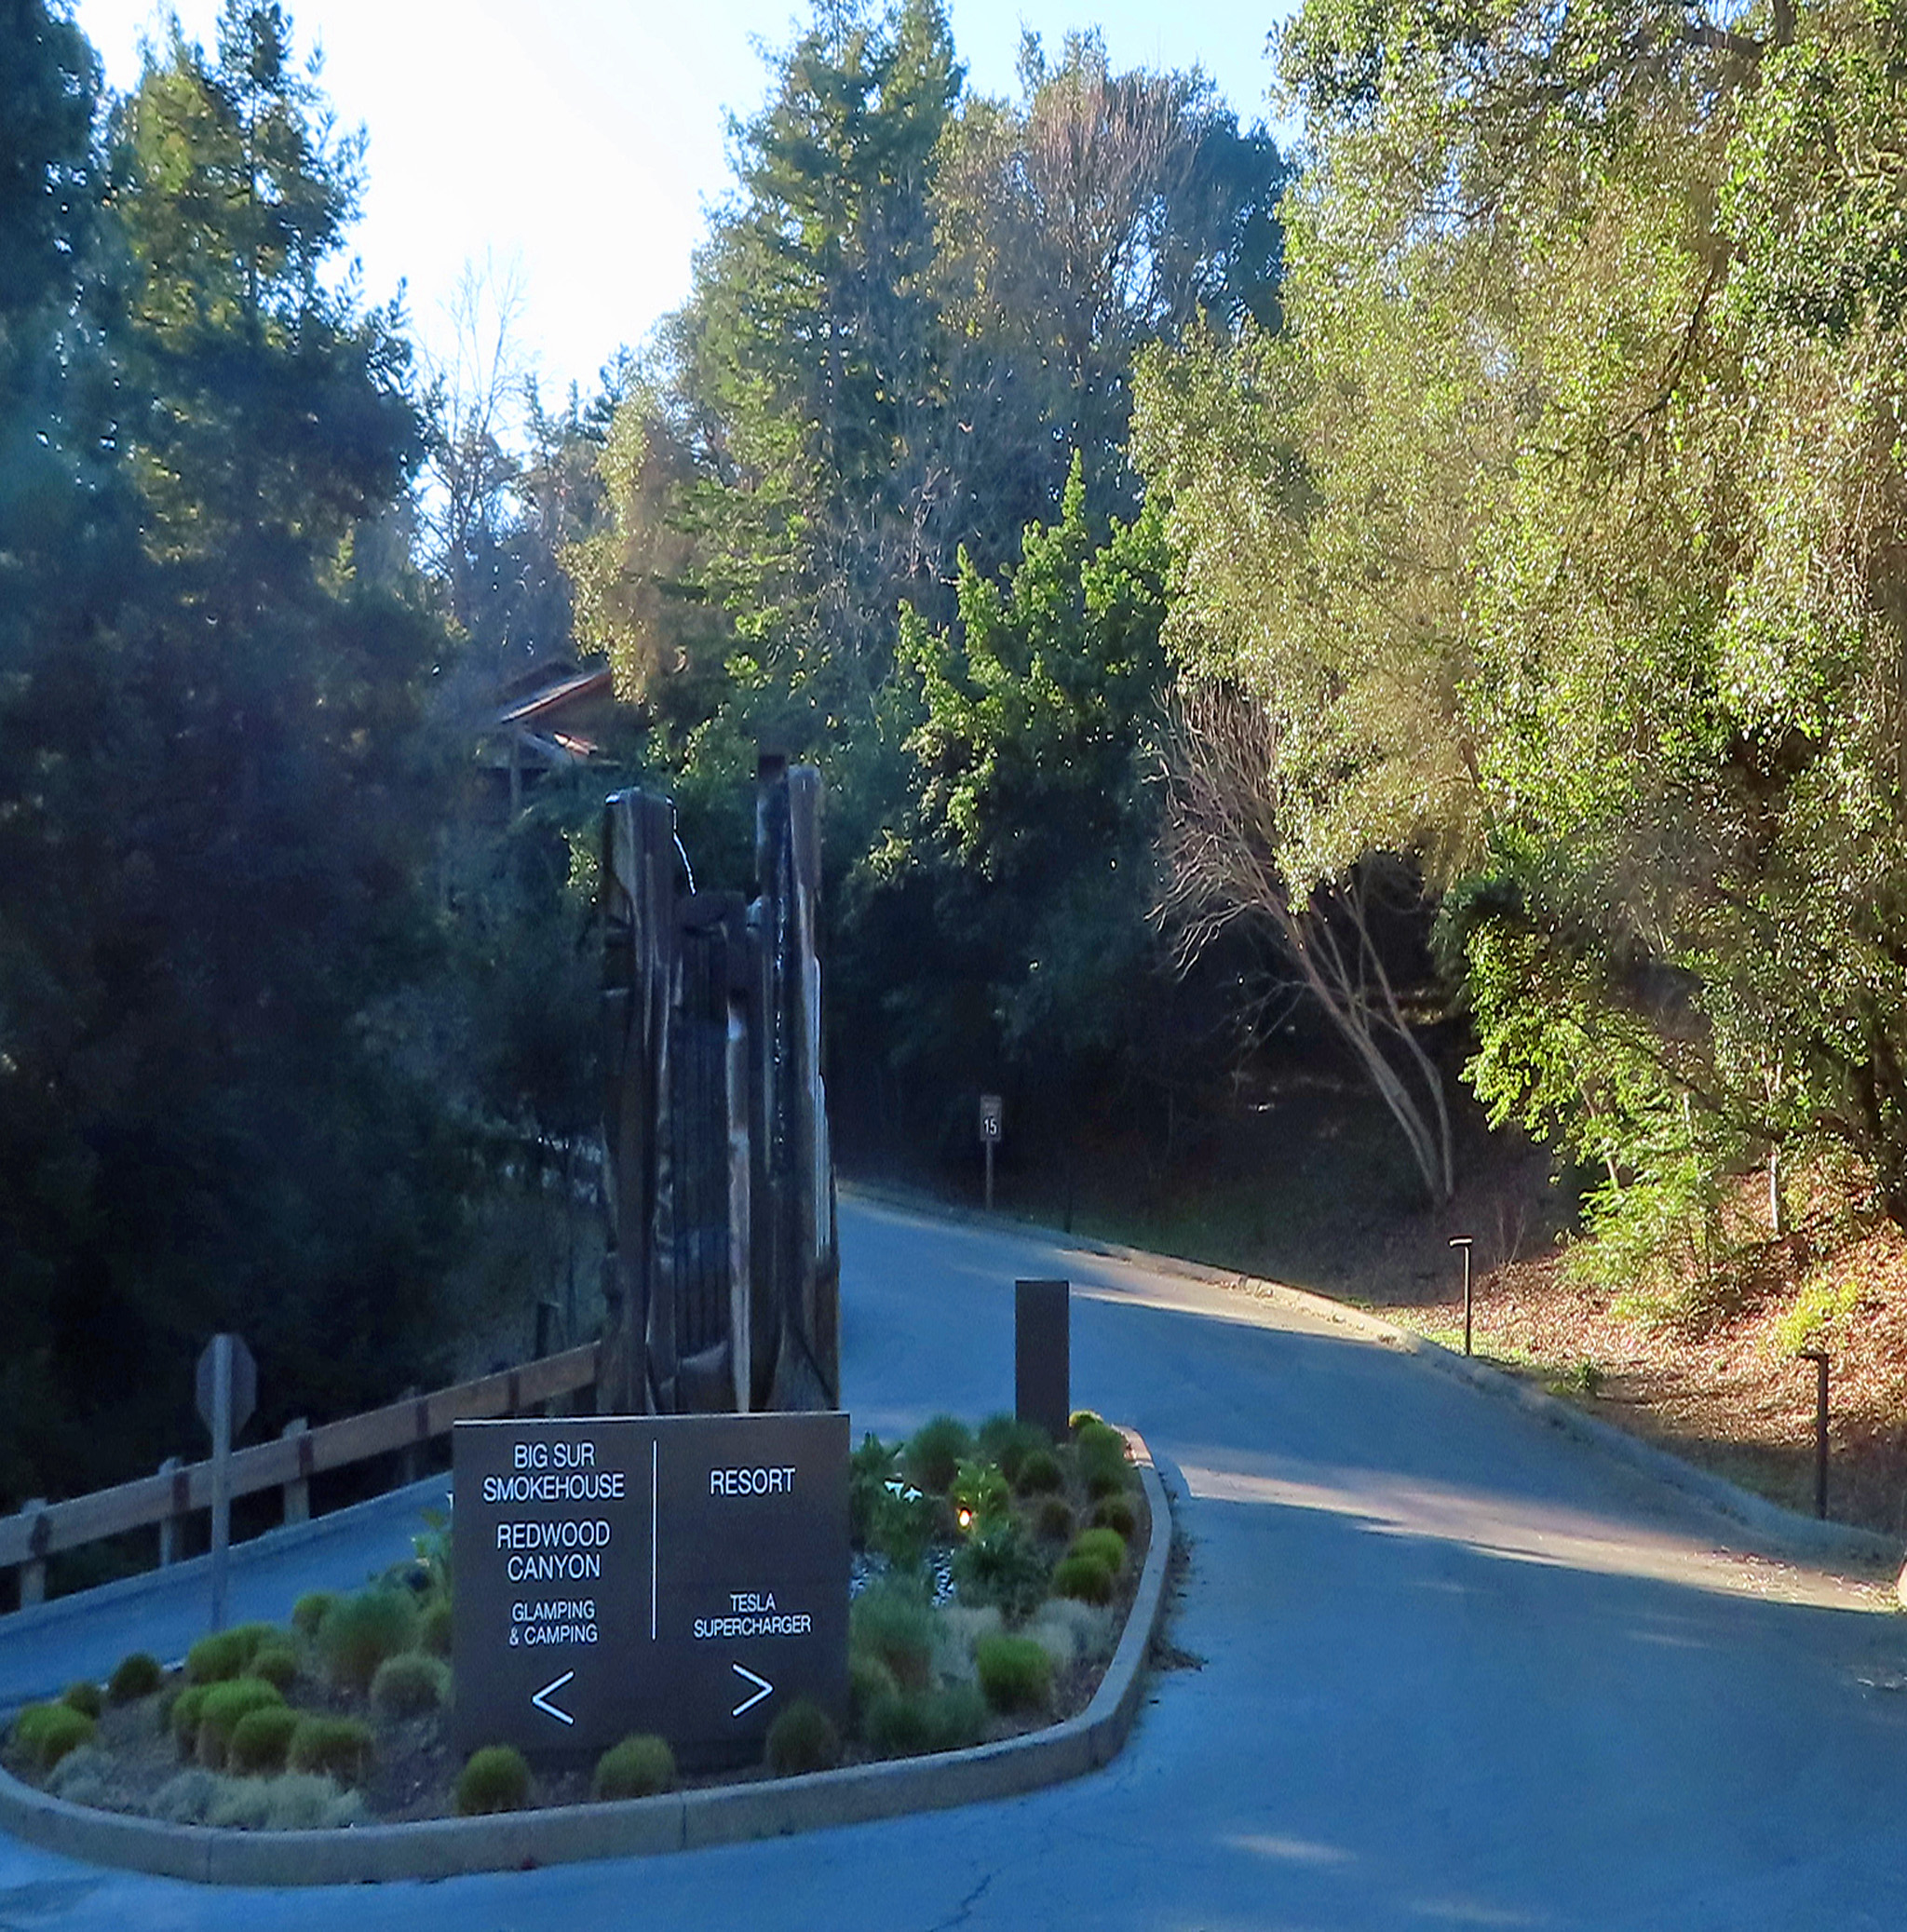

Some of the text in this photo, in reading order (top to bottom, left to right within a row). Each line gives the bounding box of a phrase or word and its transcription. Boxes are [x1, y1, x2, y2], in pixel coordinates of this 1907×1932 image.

[984, 1118, 997, 1135] 15
[515, 1443, 594, 1467] BIG SUR
[483, 1474, 624, 1501] SMOKEHOUSE
[711, 1468, 795, 1494] RESORT
[498, 1521, 609, 1548] REDWOOD
[508, 1554, 600, 1580] CANYON
[513, 1601, 594, 1621] GLAMPING
[730, 1593, 776, 1612] TESLA
[509, 1624, 597, 1645] & CAMPING
[694, 1615, 810, 1637] SUPERCHARGER
